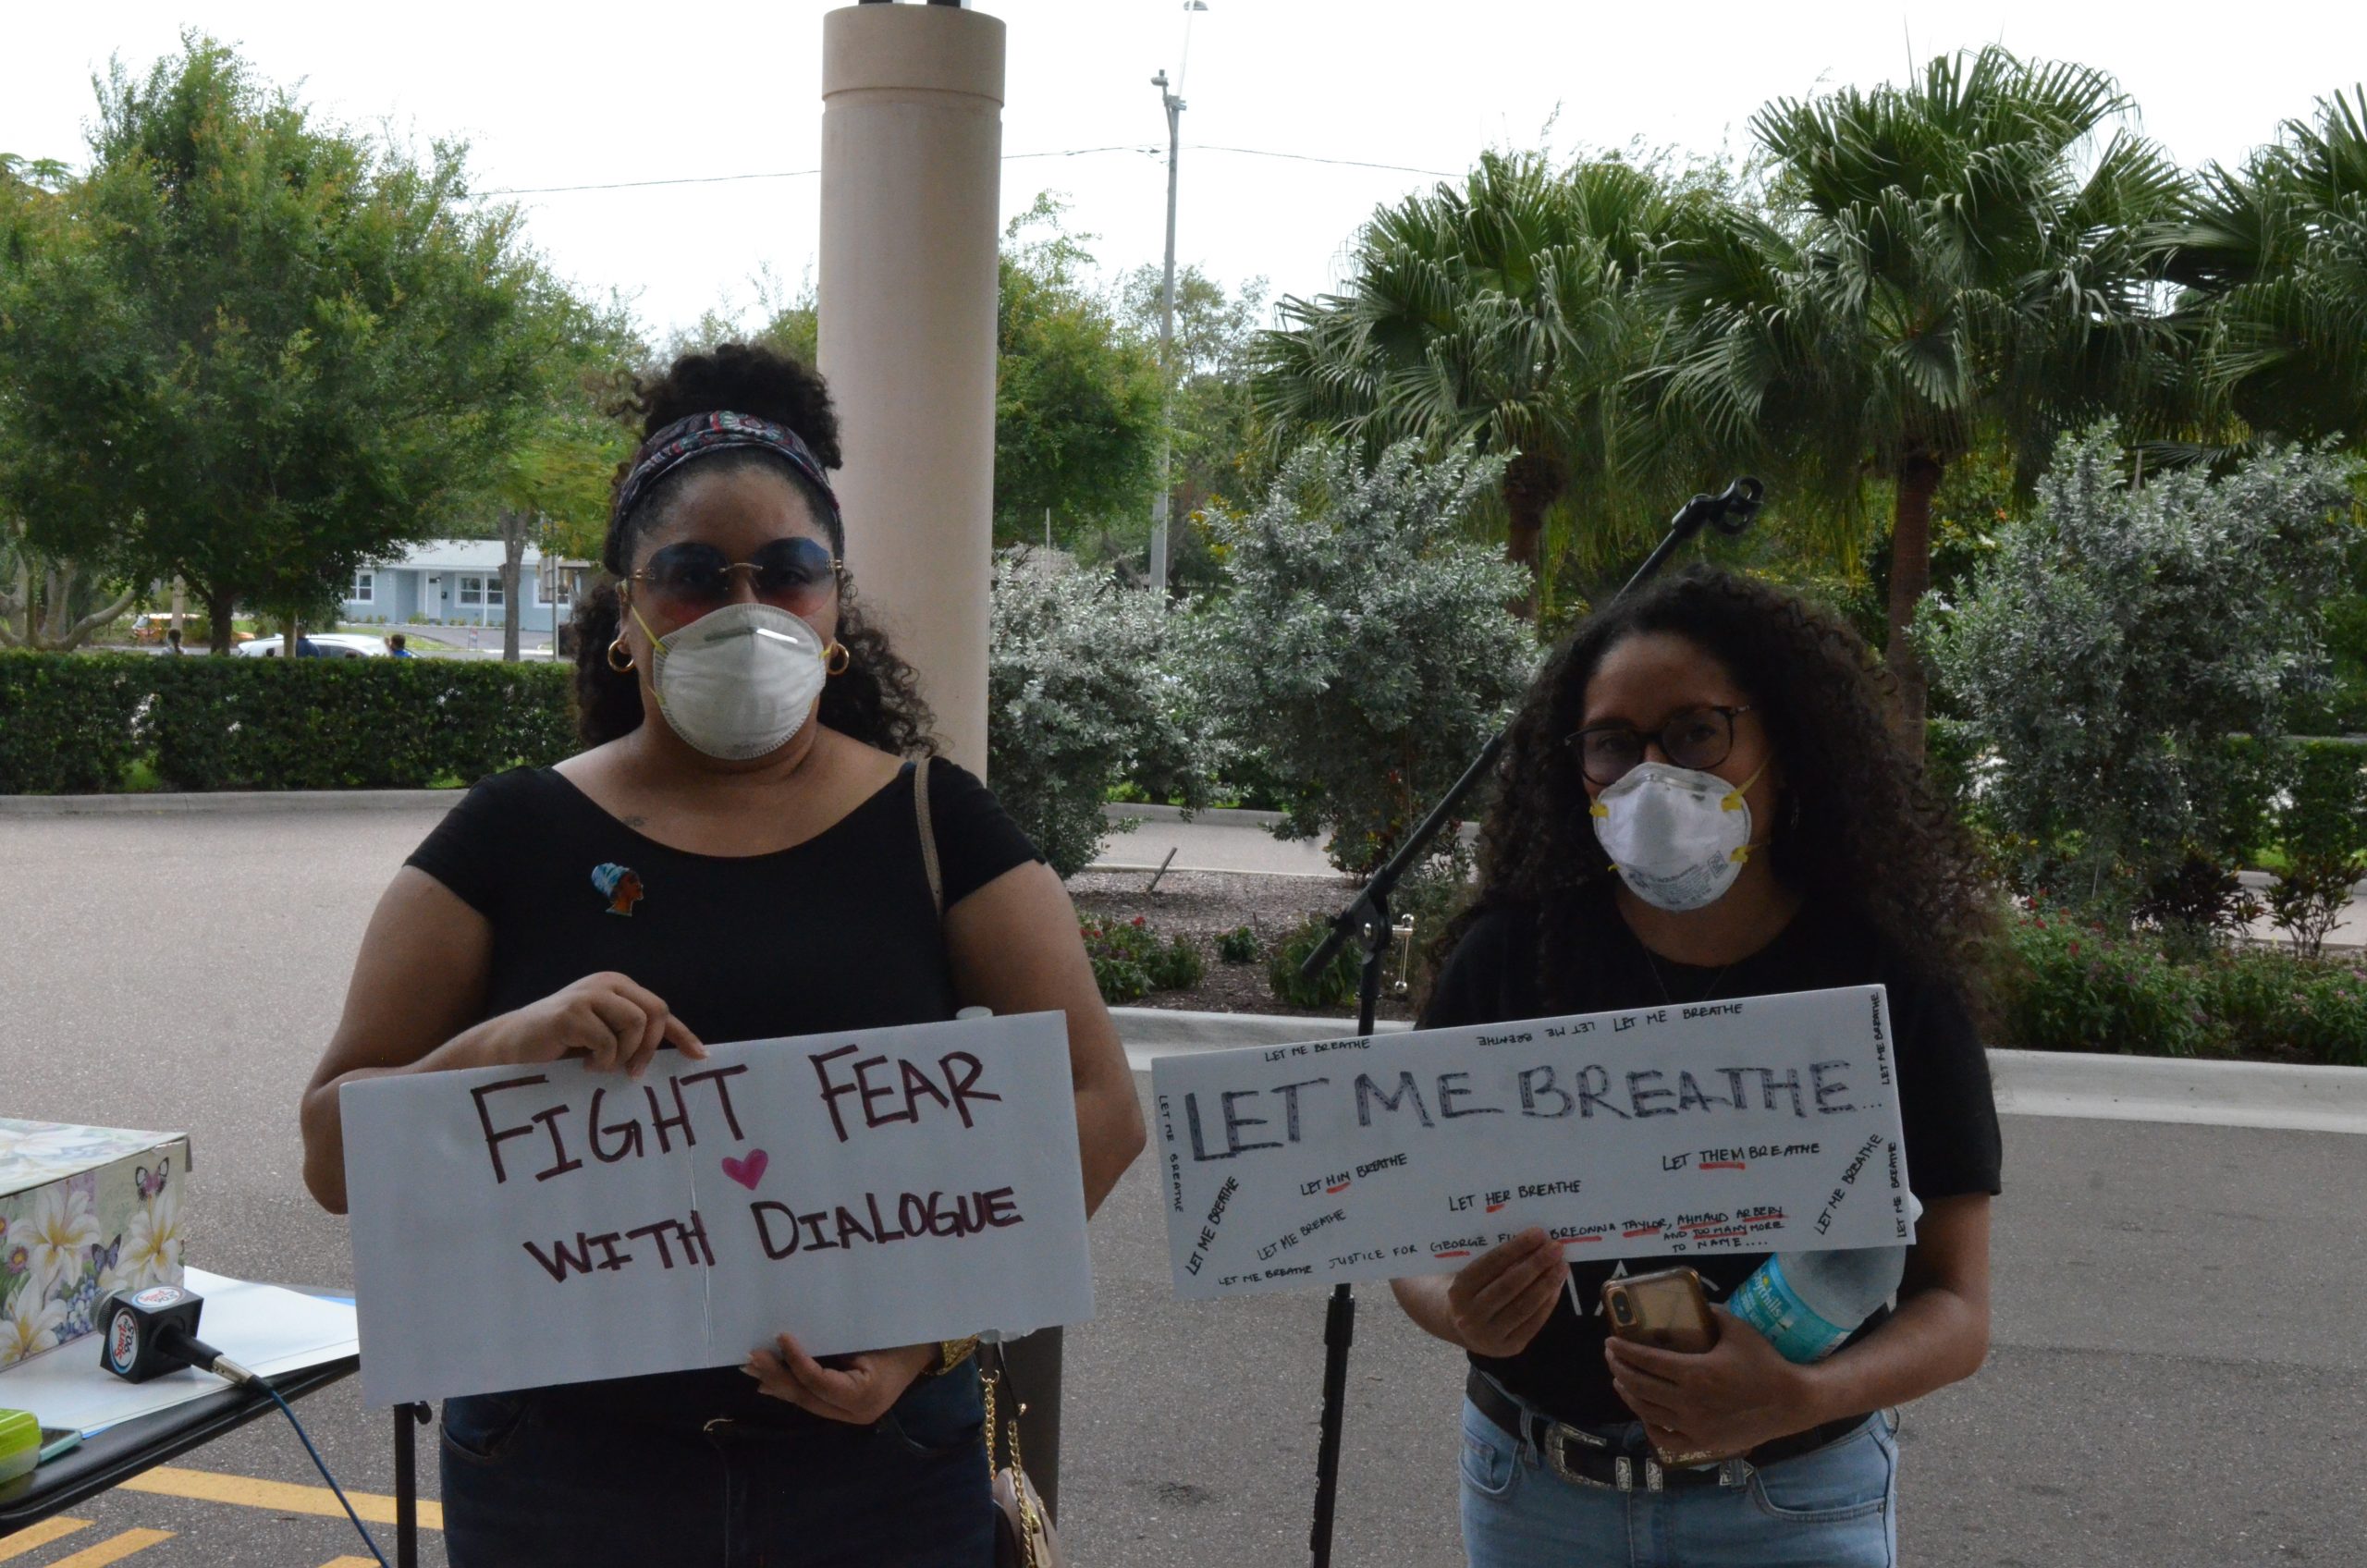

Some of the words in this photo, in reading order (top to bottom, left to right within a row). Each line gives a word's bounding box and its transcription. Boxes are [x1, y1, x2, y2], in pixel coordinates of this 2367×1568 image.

[1572, 1022, 1596, 1035] LET
[1613, 1017, 1637, 1032] LET
[1647, 1010, 1668, 1024] ME
[1683, 1003, 1744, 1019] BREATHE
[1870, 992, 1883, 1041] BREATHE
[1477, 1033, 1533, 1047] BREATHE
[1545, 1026, 1565, 1037] ME
[1265, 1048, 1287, 1061] LET
[1292, 1045, 1308, 1057] ME
[1315, 1038, 1370, 1053] BREATHE
[1876, 1042, 1885, 1061] ME
[1880, 1064, 1890, 1084] LET
[470, 1063, 748, 1184] FIGHT
[808, 1044, 1002, 1144] FEAR
[1159, 1095, 1170, 1120] LET
[1184, 1076, 1330, 1162] LET
[1354, 1070, 1505, 1128] ME
[1164, 1123, 1174, 1142] ME
[1662, 1152, 1691, 1170] LET
[1699, 1146, 1746, 1162] THEM
[1748, 1143, 1820, 1159] BREATHE
[1888, 1142, 1900, 1189] BREATHE
[1170, 1153, 1184, 1213] BREATHE
[1300, 1179, 1322, 1196] LET
[1326, 1170, 1351, 1186] HIM
[1356, 1153, 1407, 1179] BREATHE
[1814, 1207, 1833, 1235] LET
[1828, 1188, 1846, 1209] ME
[1841, 1133, 1883, 1185] BREATHE
[1448, 1194, 1476, 1212] LET
[1485, 1190, 1511, 1206] HER
[1518, 1180, 1582, 1199] BREATHE
[1894, 1195, 1903, 1214] ME
[522, 1209, 716, 1283] WITH
[750, 1186, 1024, 1261] DIALOGUE
[1184, 1250, 1204, 1277] LET
[1197, 1225, 1216, 1252] ME
[1208, 1175, 1240, 1226] BREATHE
[1257, 1243, 1278, 1262] LET
[1280, 1232, 1299, 1250] ME
[1300, 1208, 1347, 1237] BREATHE
[1329, 1250, 1385, 1269] JUSTICE
[1393, 1243, 1417, 1256] FOR
[1429, 1236, 1488, 1252] GEORGE
[1549, 1222, 1616, 1241] BREONNA
[1622, 1217, 1672, 1232] TAYLOR,
[1677, 1211, 1729, 1226] AHMAUD
[1736, 1206, 1784, 1219] ARBERY
[1663, 1230, 1686, 1241] AND
[1693, 1227, 1710, 1235] TOO
[1713, 1224, 1747, 1236] MANY
[1749, 1220, 1784, 1232] MORE
[1896, 1218, 1907, 1238] LET
[1672, 1243, 1686, 1253] TO
[1218, 1276, 1239, 1287] LET
[1243, 1274, 1262, 1283] ME
[1265, 1265, 1314, 1280] BREATHE
[124, 1326, 134, 1354] 90.5
